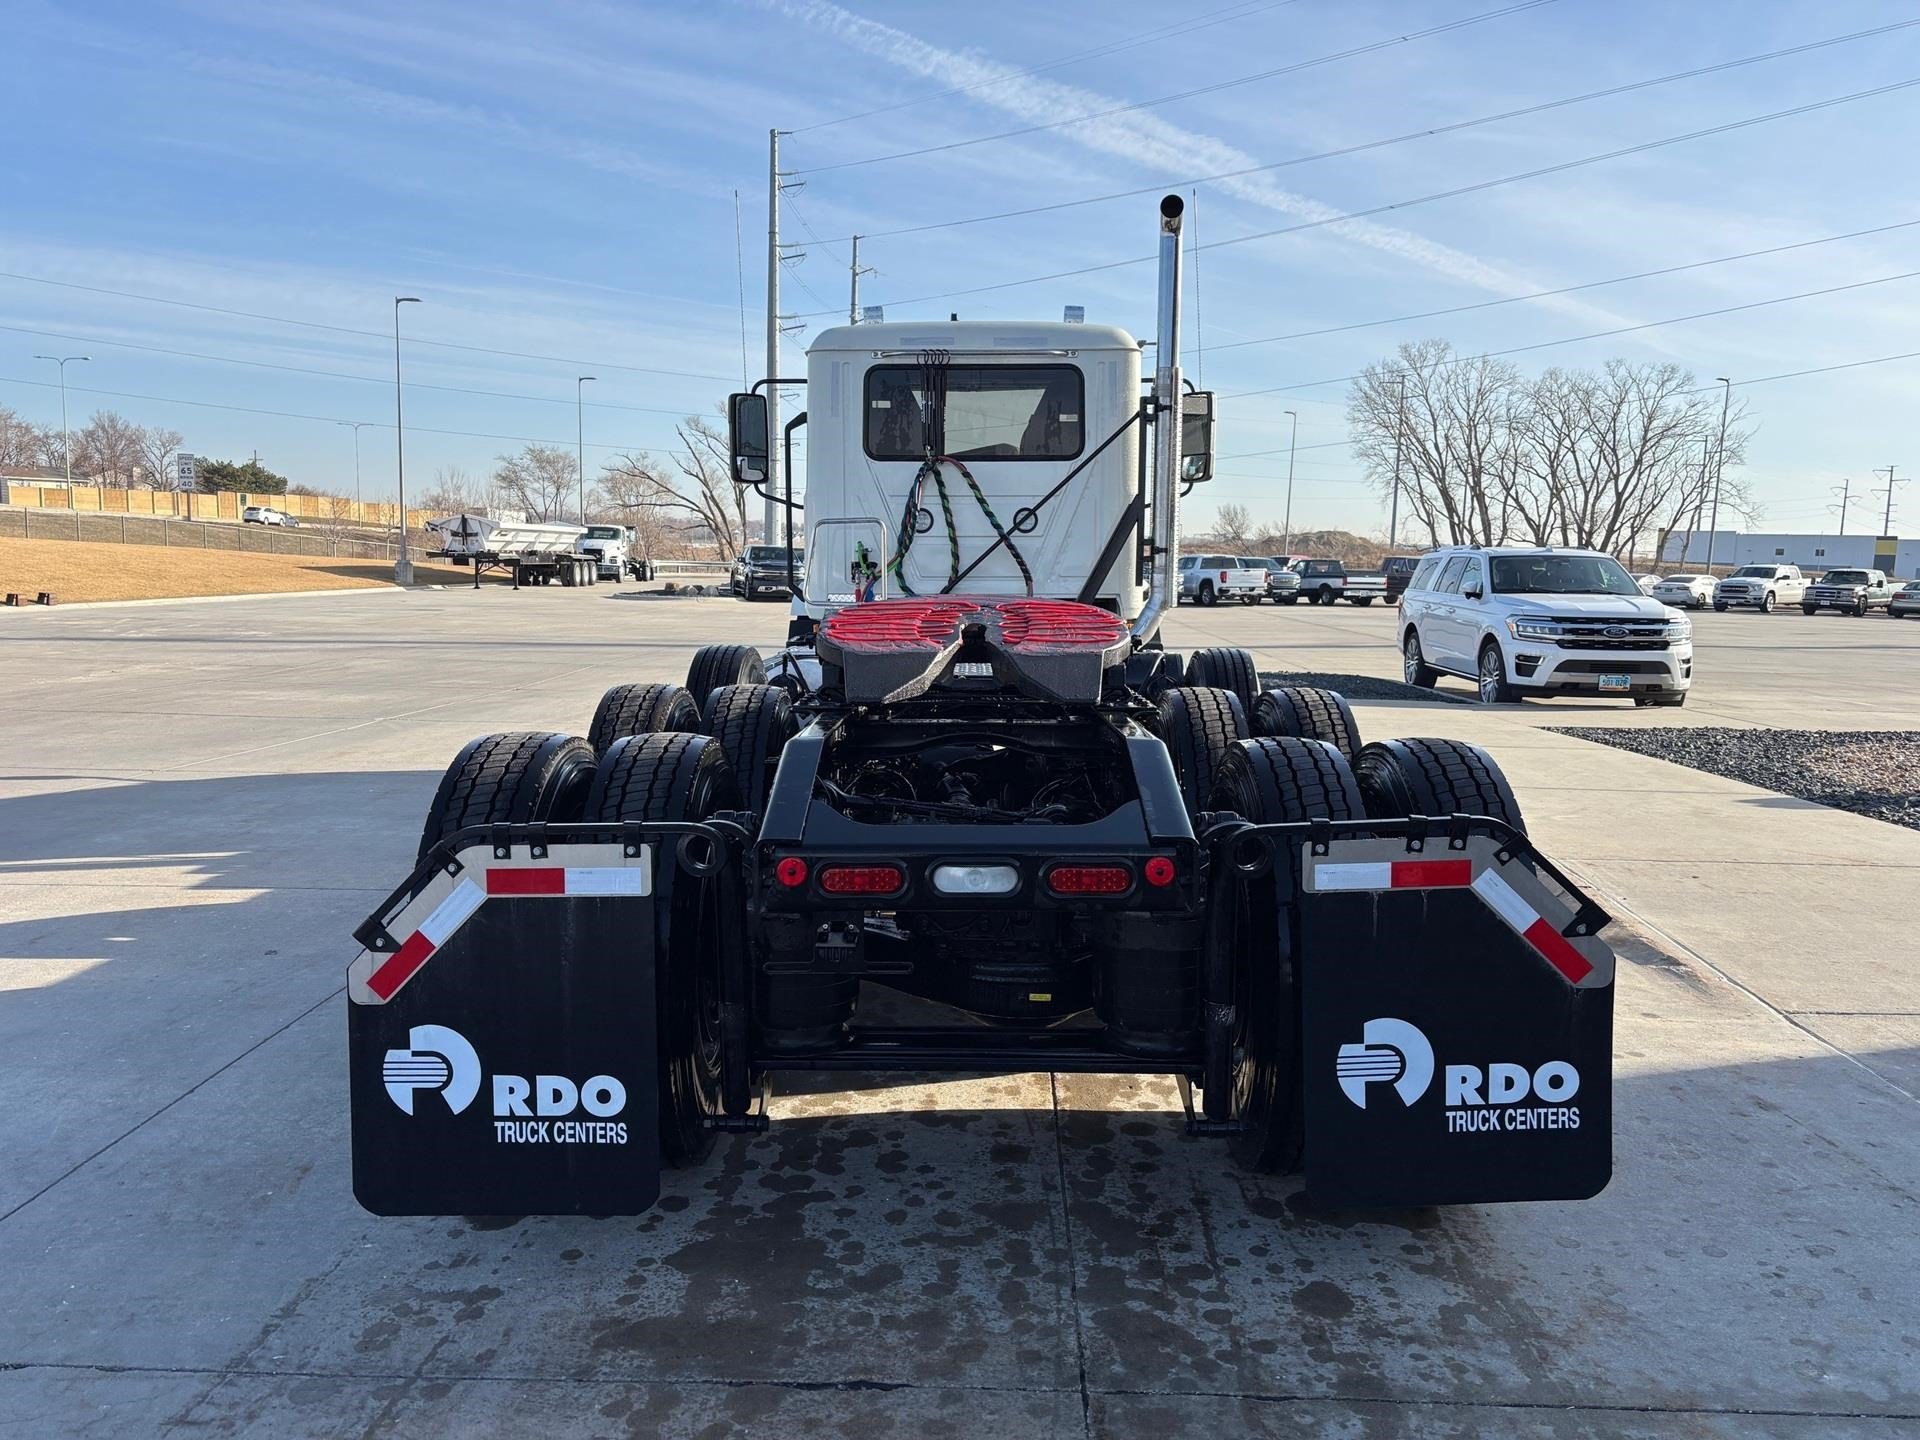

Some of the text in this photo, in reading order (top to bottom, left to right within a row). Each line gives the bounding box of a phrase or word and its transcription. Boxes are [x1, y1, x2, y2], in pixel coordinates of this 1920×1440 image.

[492, 1074, 627, 1118] RDO
[1445, 1061, 1580, 1106] RDO
[493, 1121, 628, 1145] TRUCK CENTERS
[1445, 1107, 1580, 1133] TRUCK CENTERS
